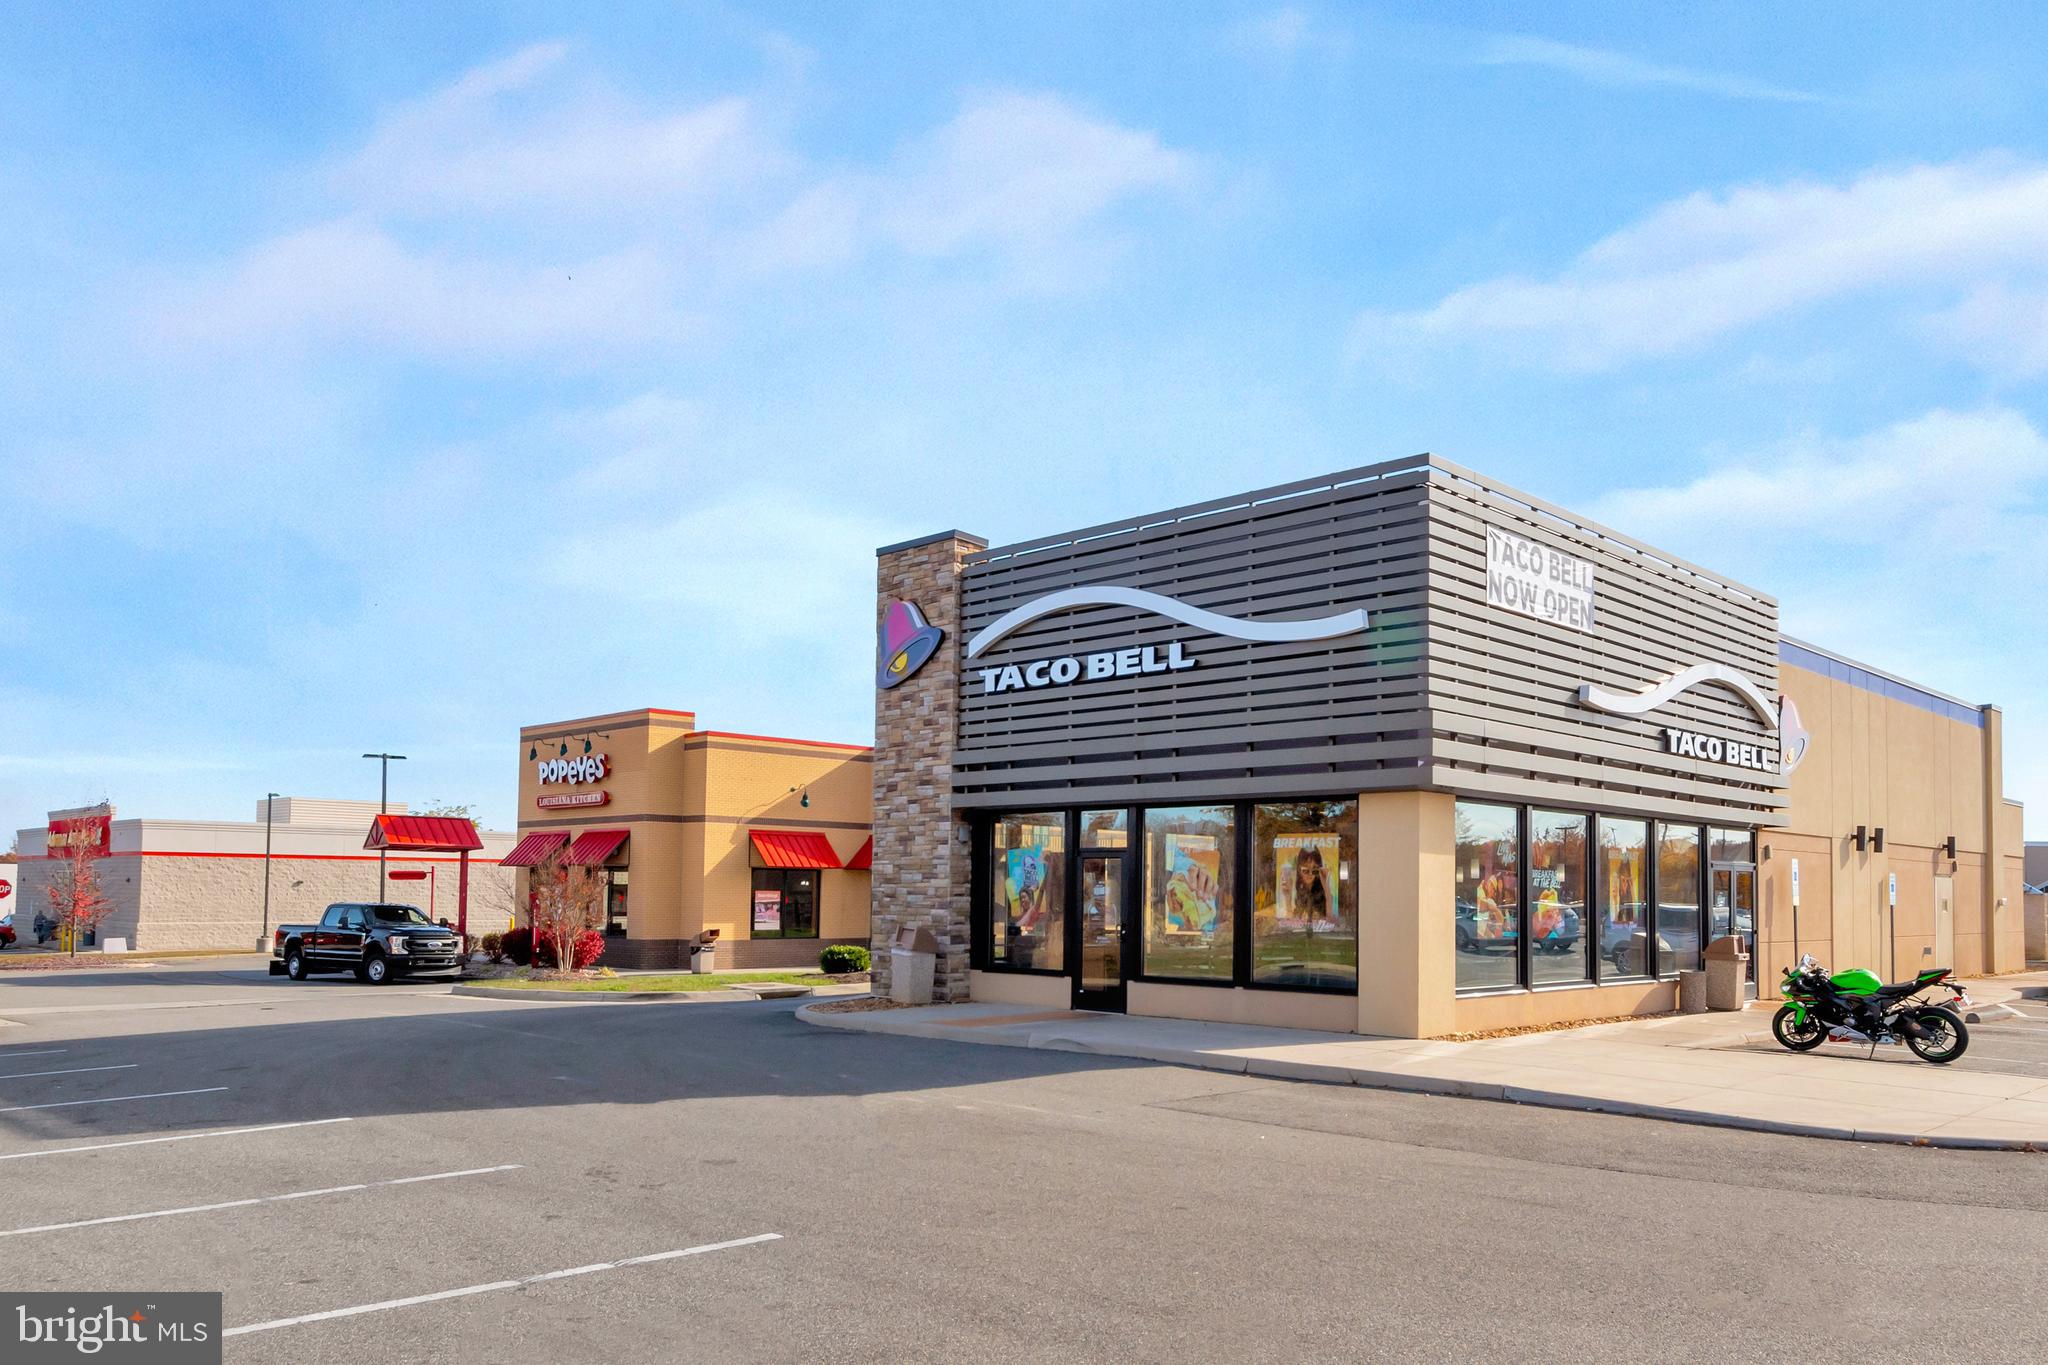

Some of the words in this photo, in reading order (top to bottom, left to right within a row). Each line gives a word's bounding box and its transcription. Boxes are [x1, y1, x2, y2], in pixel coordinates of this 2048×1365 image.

[1488, 529, 1543, 576] TACO
[1549, 552, 1593, 594] BELL
[1488, 569, 1538, 613] NOW
[1544, 588, 1594, 631] OPEN
[979, 657, 1080, 693] TACO
[1087, 642, 1196, 680] BELL
[1666, 728, 1722, 760] TACO
[1726, 741, 1772, 770] BELL
[539, 796, 570, 807] LOUISIANA
[570, 794, 601, 804] KITCHEN
[1273, 837, 1342, 849] BREAKFAST
